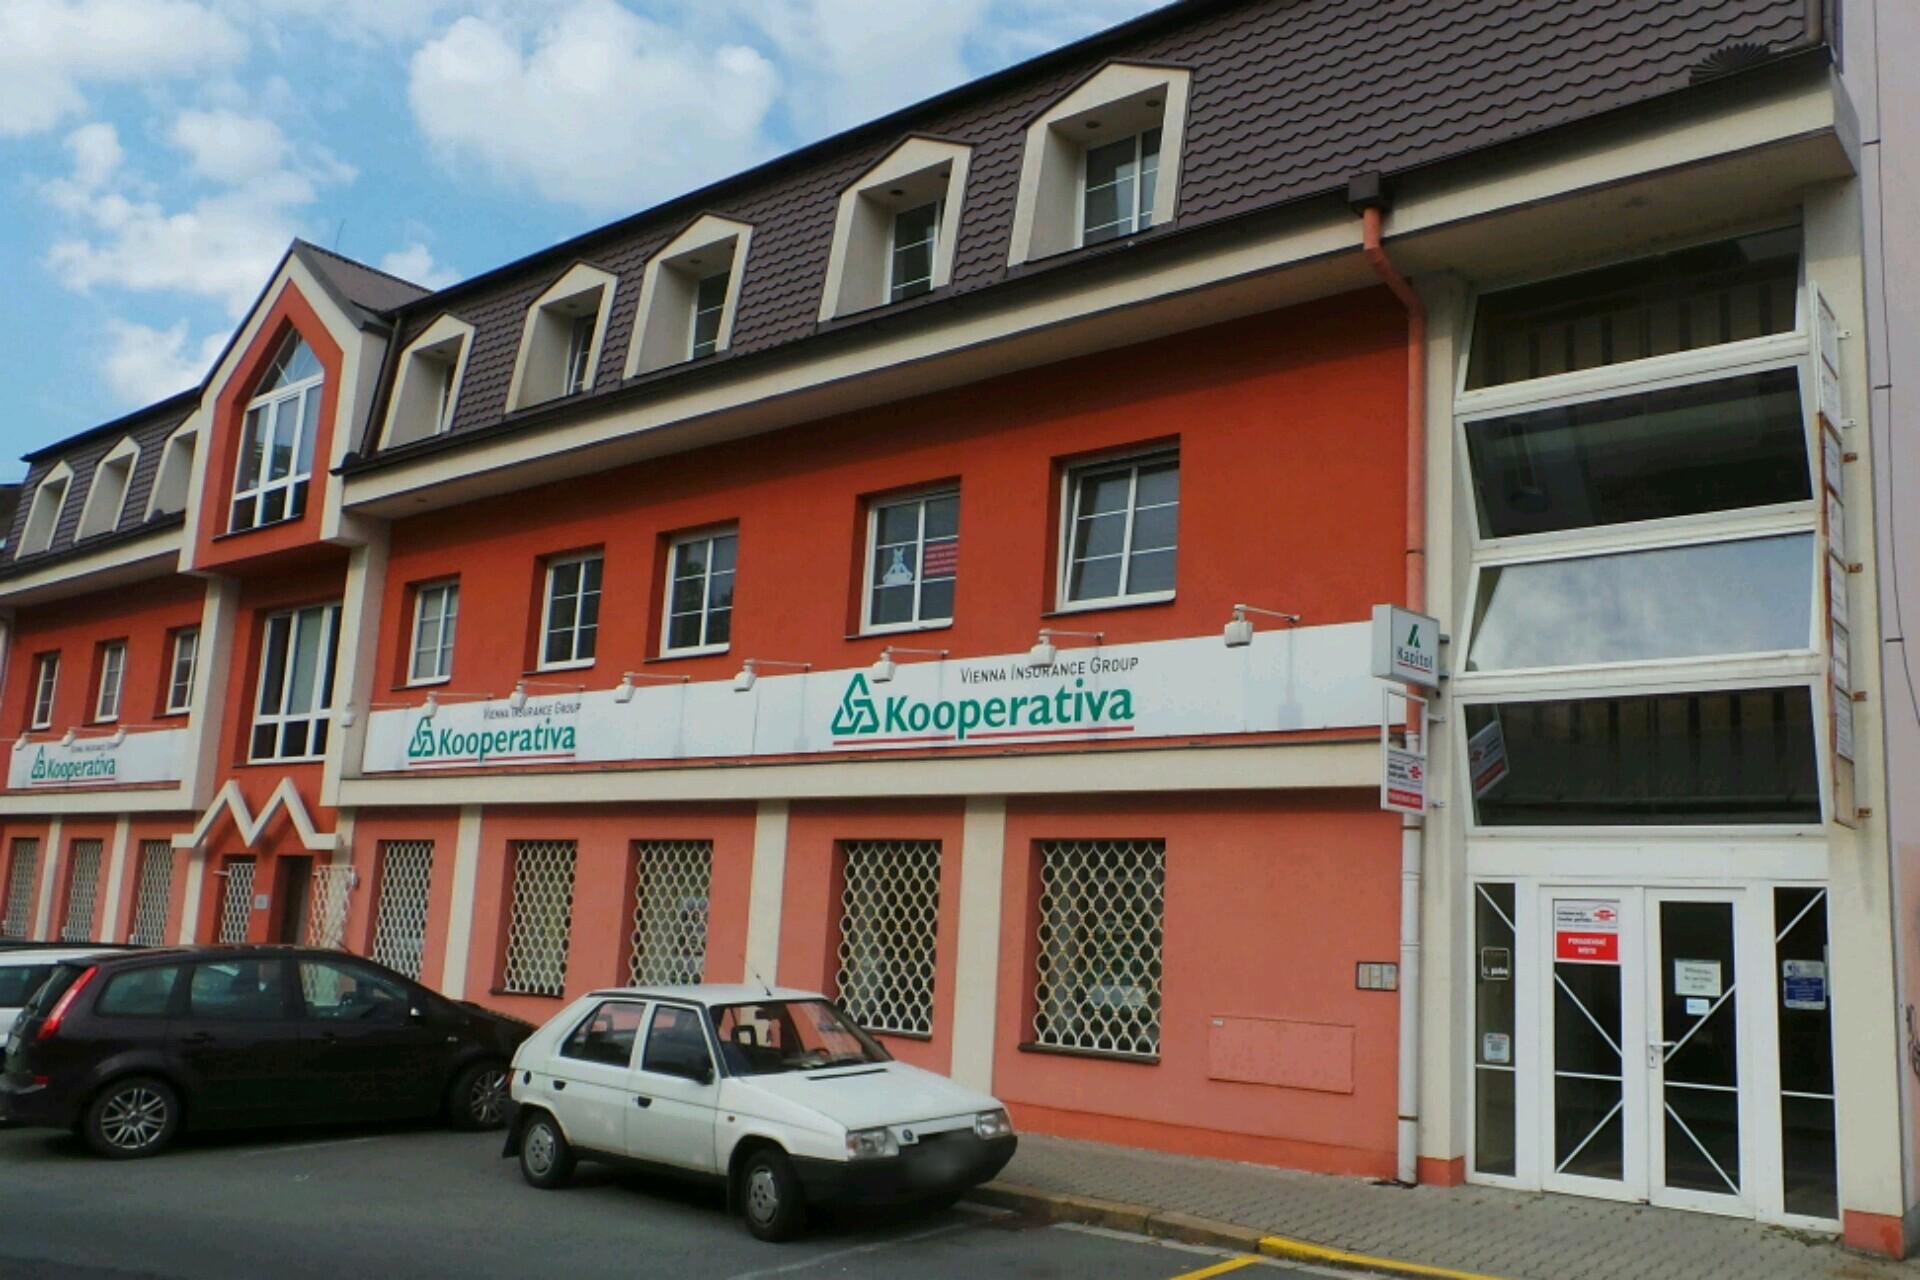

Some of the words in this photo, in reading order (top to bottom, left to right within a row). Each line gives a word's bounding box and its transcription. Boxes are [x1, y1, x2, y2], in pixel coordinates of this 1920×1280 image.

[960, 667, 1006, 684] VIENNA
[1090, 656, 1139, 674] GROUP
[1397, 646, 1433, 669] Kapitol
[885, 677, 1135, 740] Kooperativa
[438, 717, 576, 761] Kooperativa
[47, 752, 116, 780] Kooperativa
